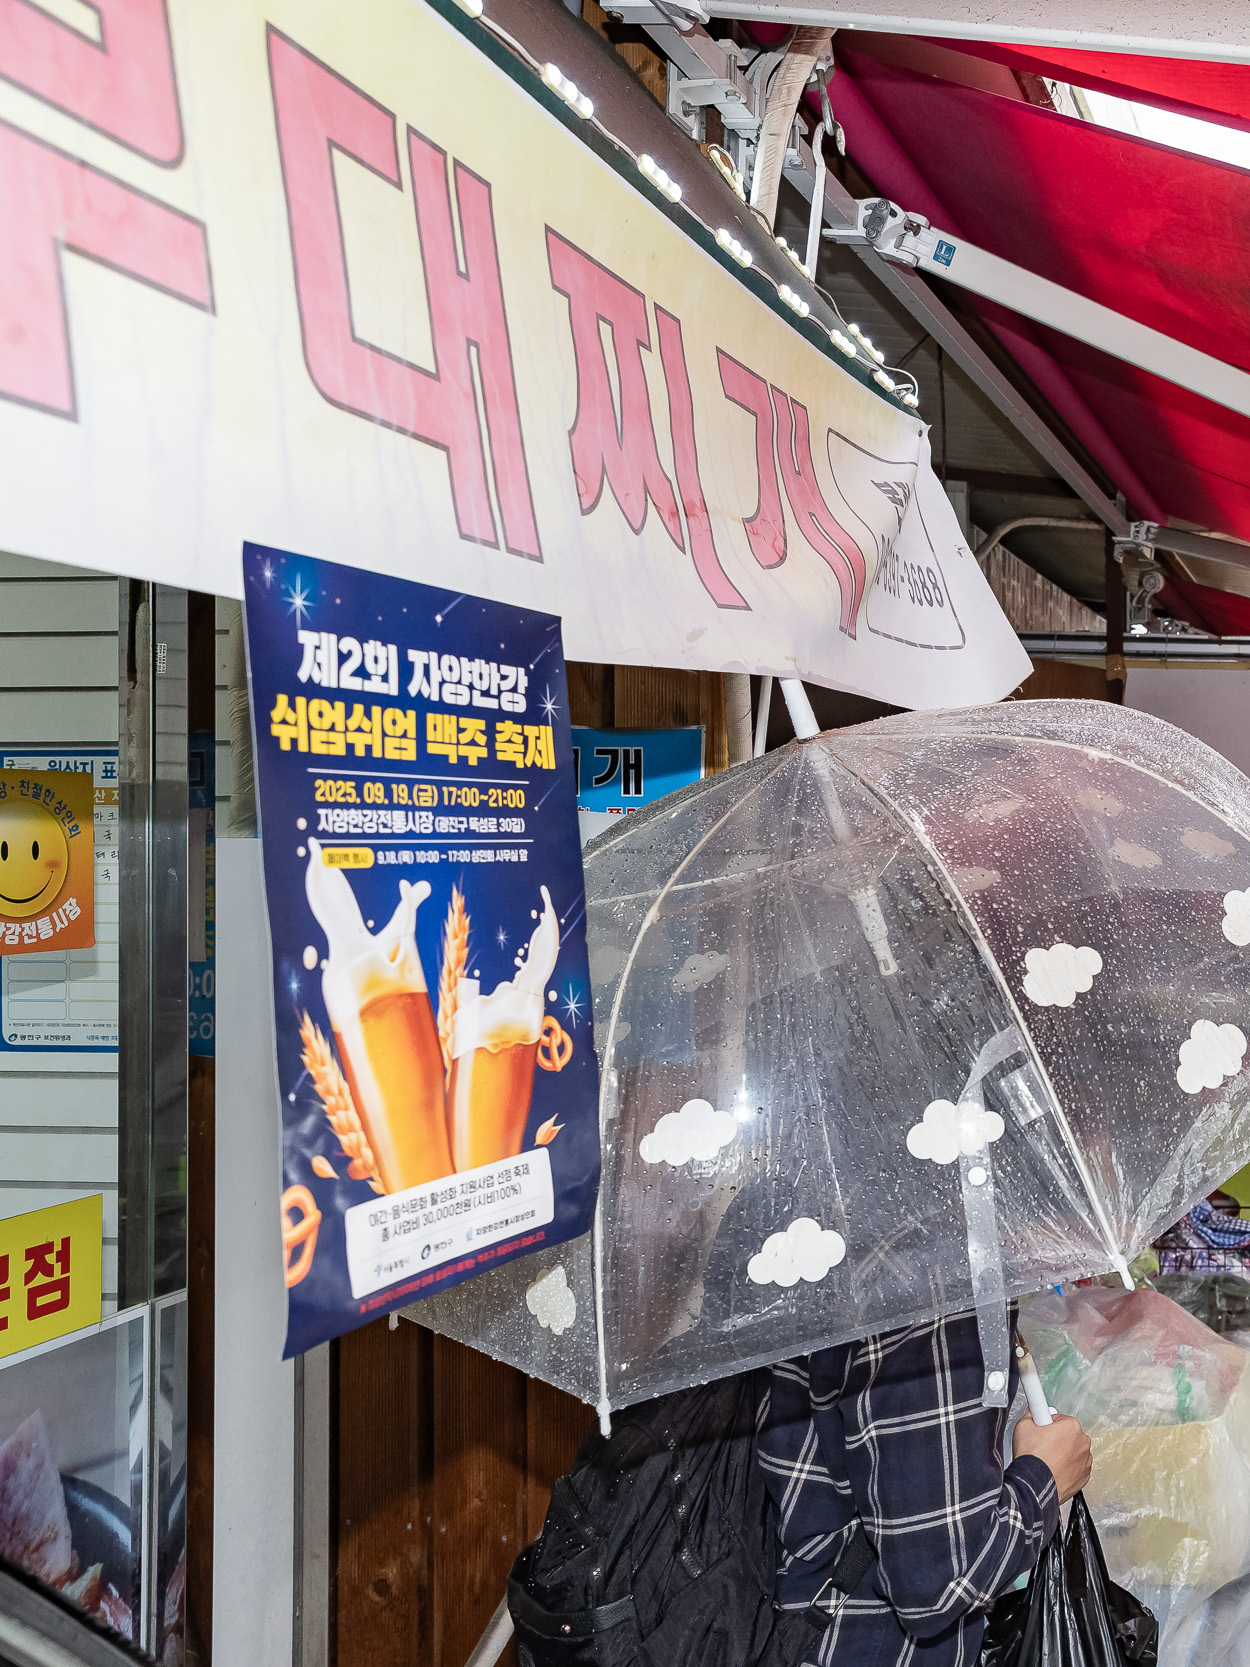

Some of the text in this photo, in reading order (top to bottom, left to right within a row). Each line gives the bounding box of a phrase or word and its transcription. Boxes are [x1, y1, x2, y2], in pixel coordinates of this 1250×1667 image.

[297, 629, 528, 713] 제2회 자양한강
[270, 693, 556, 770] 쉬엄쉬엄 맥주 축제
[101, 761, 119, 779] 표
[314, 779, 361, 804] 2025.
[363, 781, 389, 805] 09.
[442, 786, 525, 808] 17:00~21:00
[573, 746, 644, 797] 개
[316, 808, 526, 834] 자양한강전통시장 (광진구 뚝섬로 30길)
[0, 1236, 71, 1322] 점
